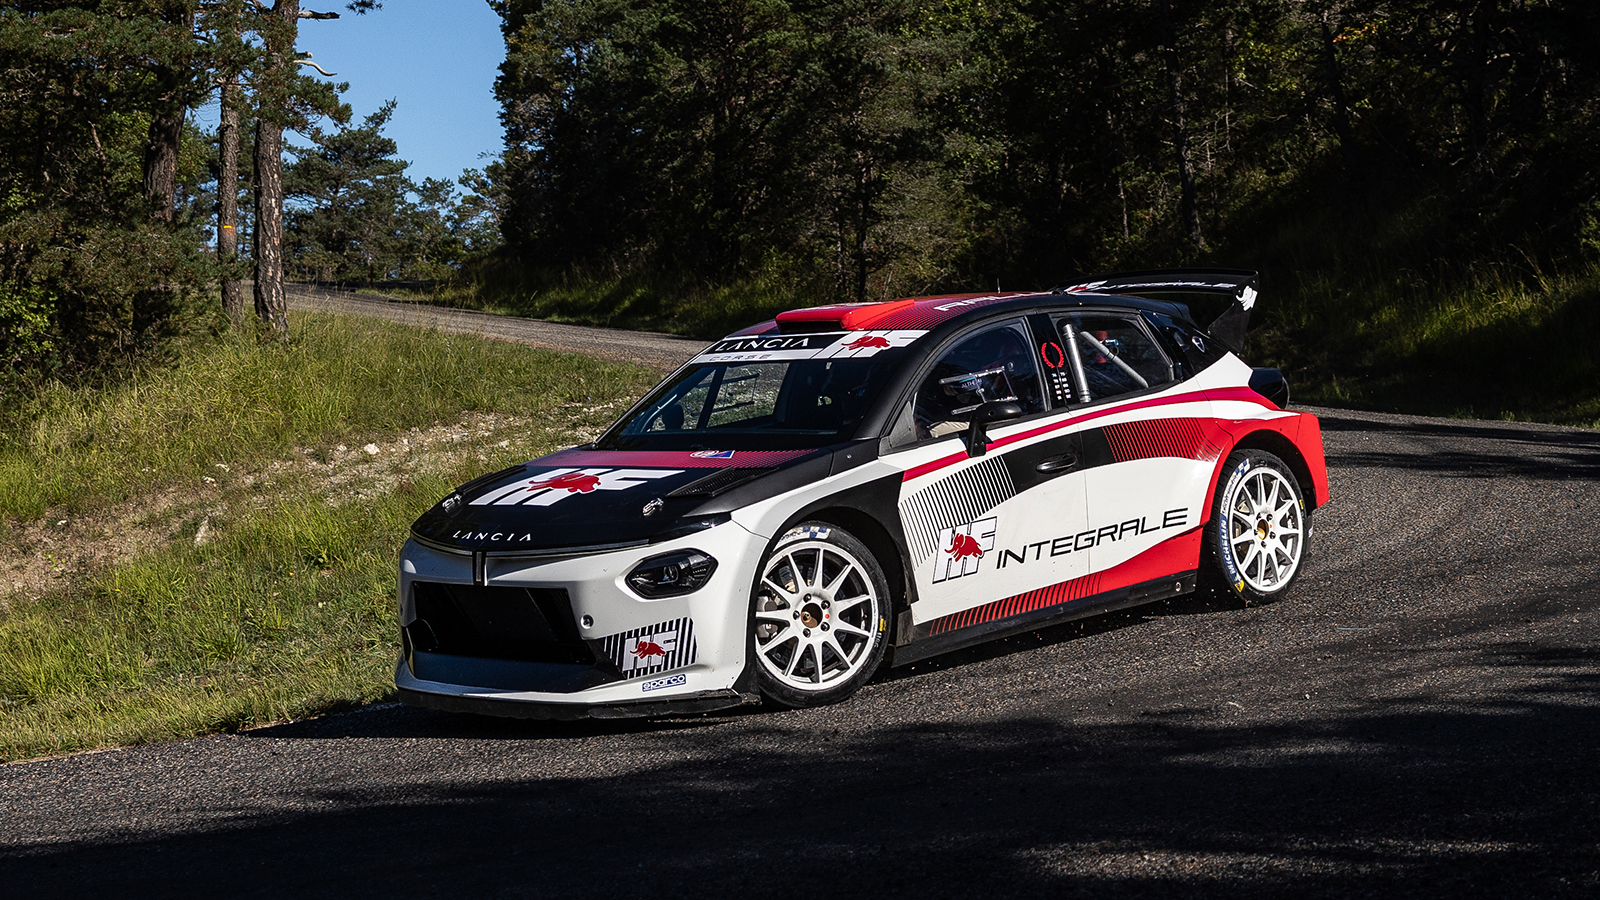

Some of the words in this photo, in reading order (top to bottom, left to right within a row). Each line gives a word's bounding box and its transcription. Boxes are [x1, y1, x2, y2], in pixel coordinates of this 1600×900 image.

[709, 353, 773, 362] CORSE
[714, 337, 809, 351] LANCIA
[452, 530, 532, 542] LANCIA
[932, 516, 997, 584] HF
[996, 507, 1189, 569] INTEGRALE
[1220, 519, 1237, 575] MICHELIN
[622, 629, 677, 672] HF
[642, 674, 686, 691] sparco
